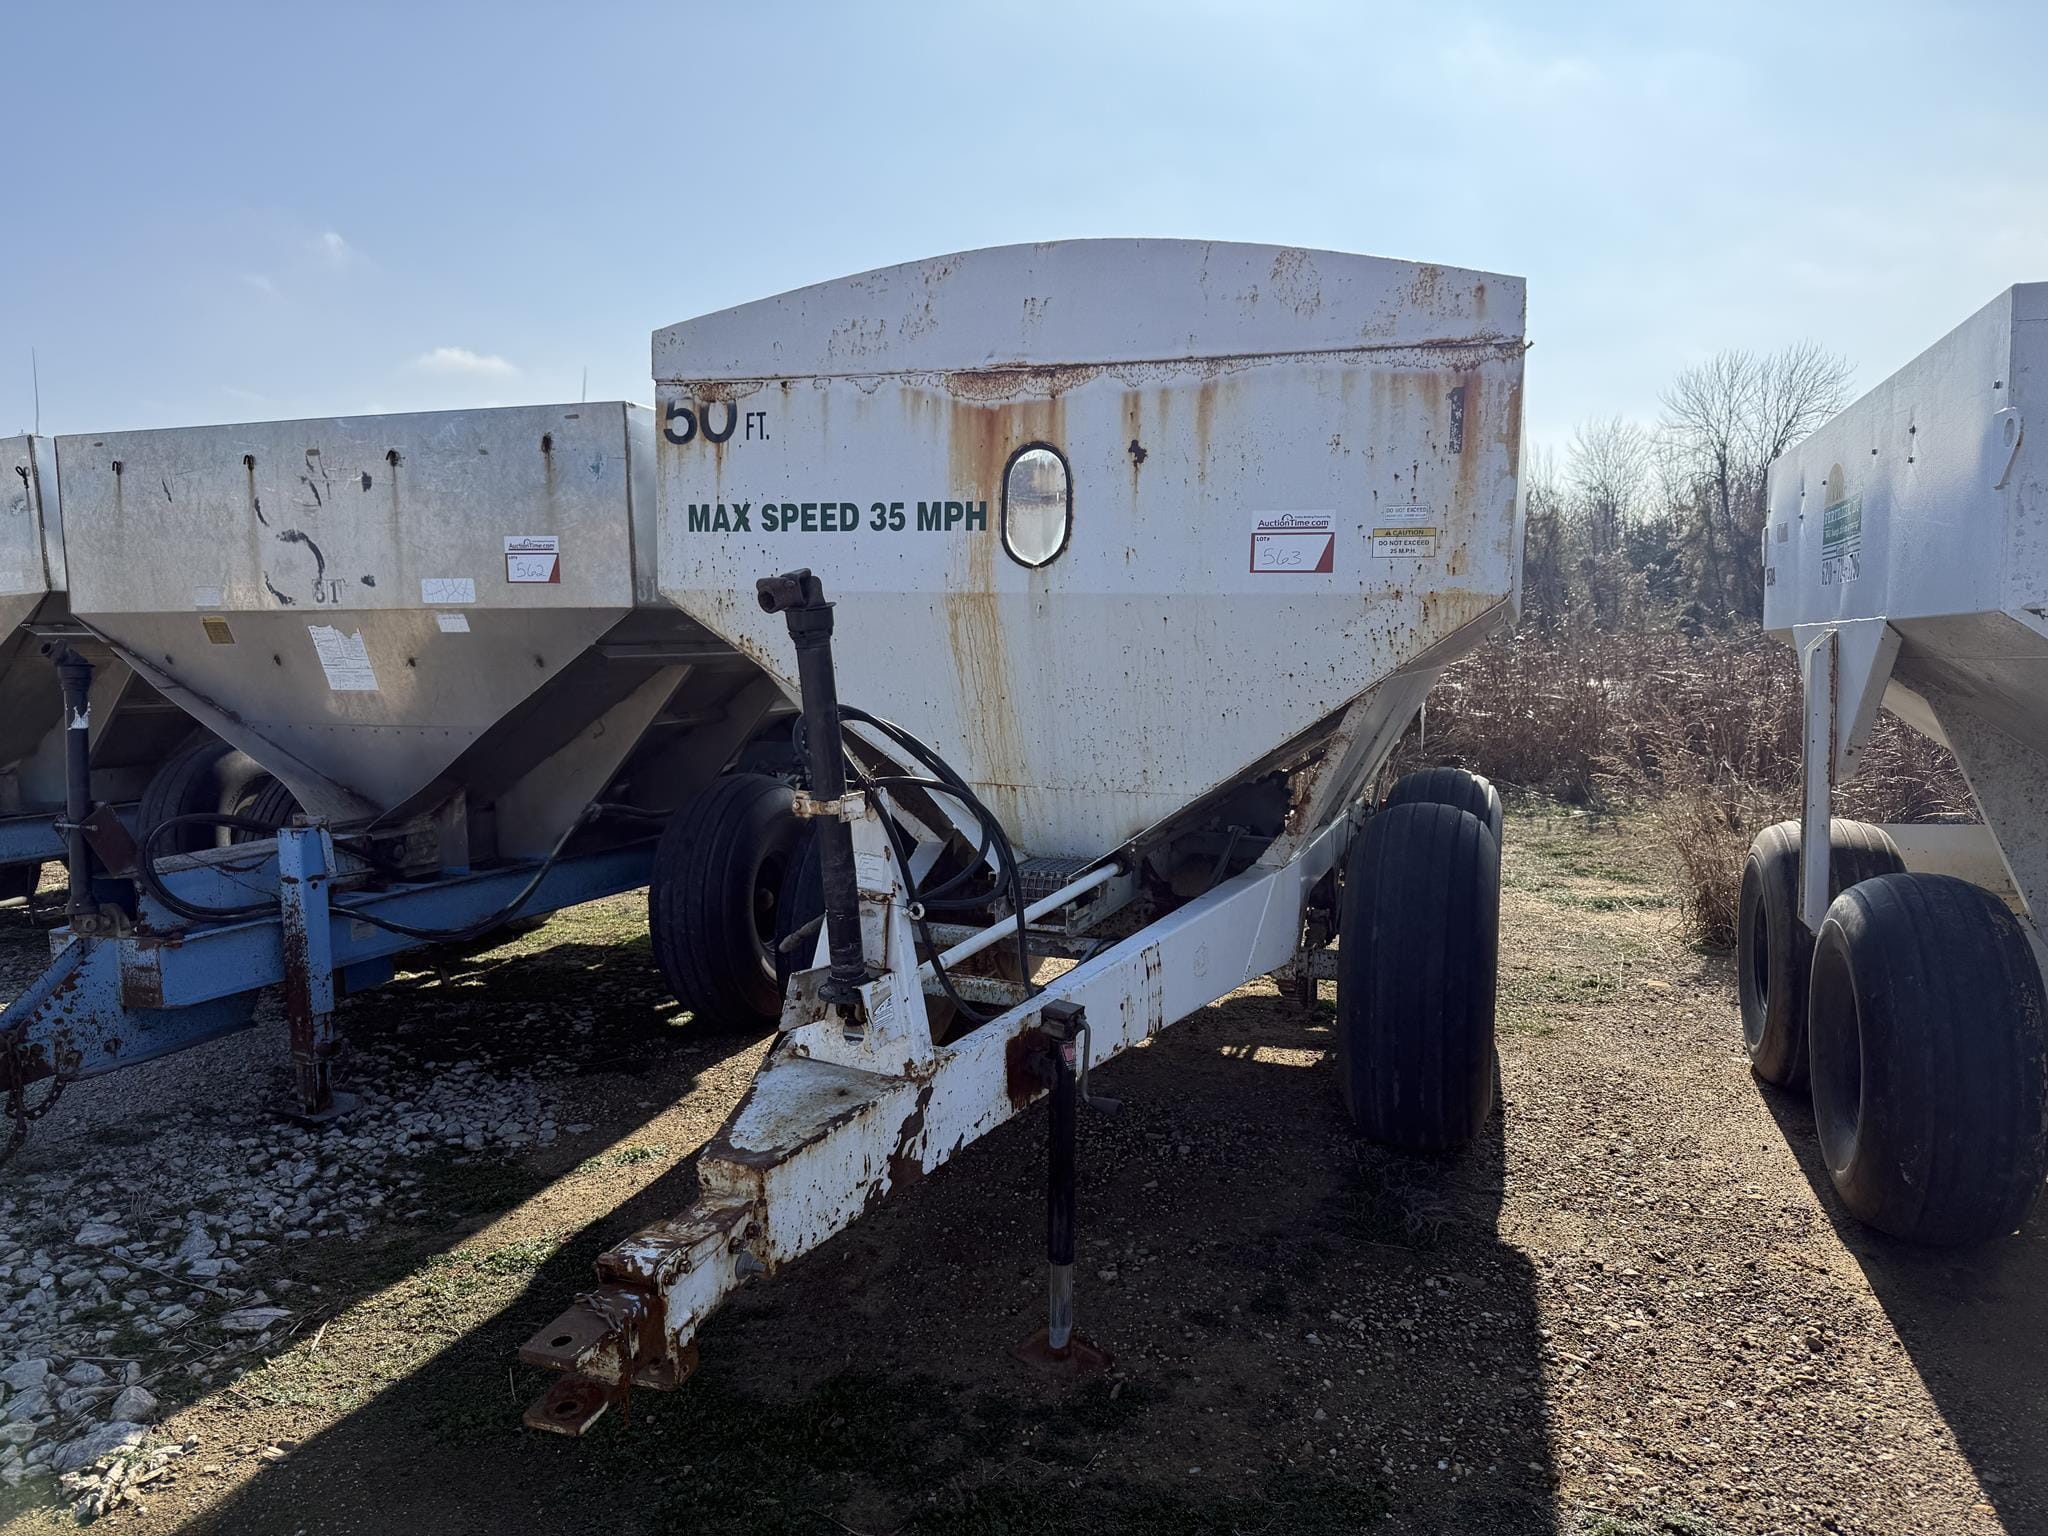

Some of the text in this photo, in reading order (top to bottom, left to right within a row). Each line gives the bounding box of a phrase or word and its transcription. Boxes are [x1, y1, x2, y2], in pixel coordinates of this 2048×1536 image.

[663, 397, 770, 444] 50 FT.
[688, 501, 987, 532] MAX SPEED 35 MPH
[1258, 519, 1329, 528] AuctionTime.com
[1262, 548, 1302, 566] 563
[516, 562, 546, 577] 562
